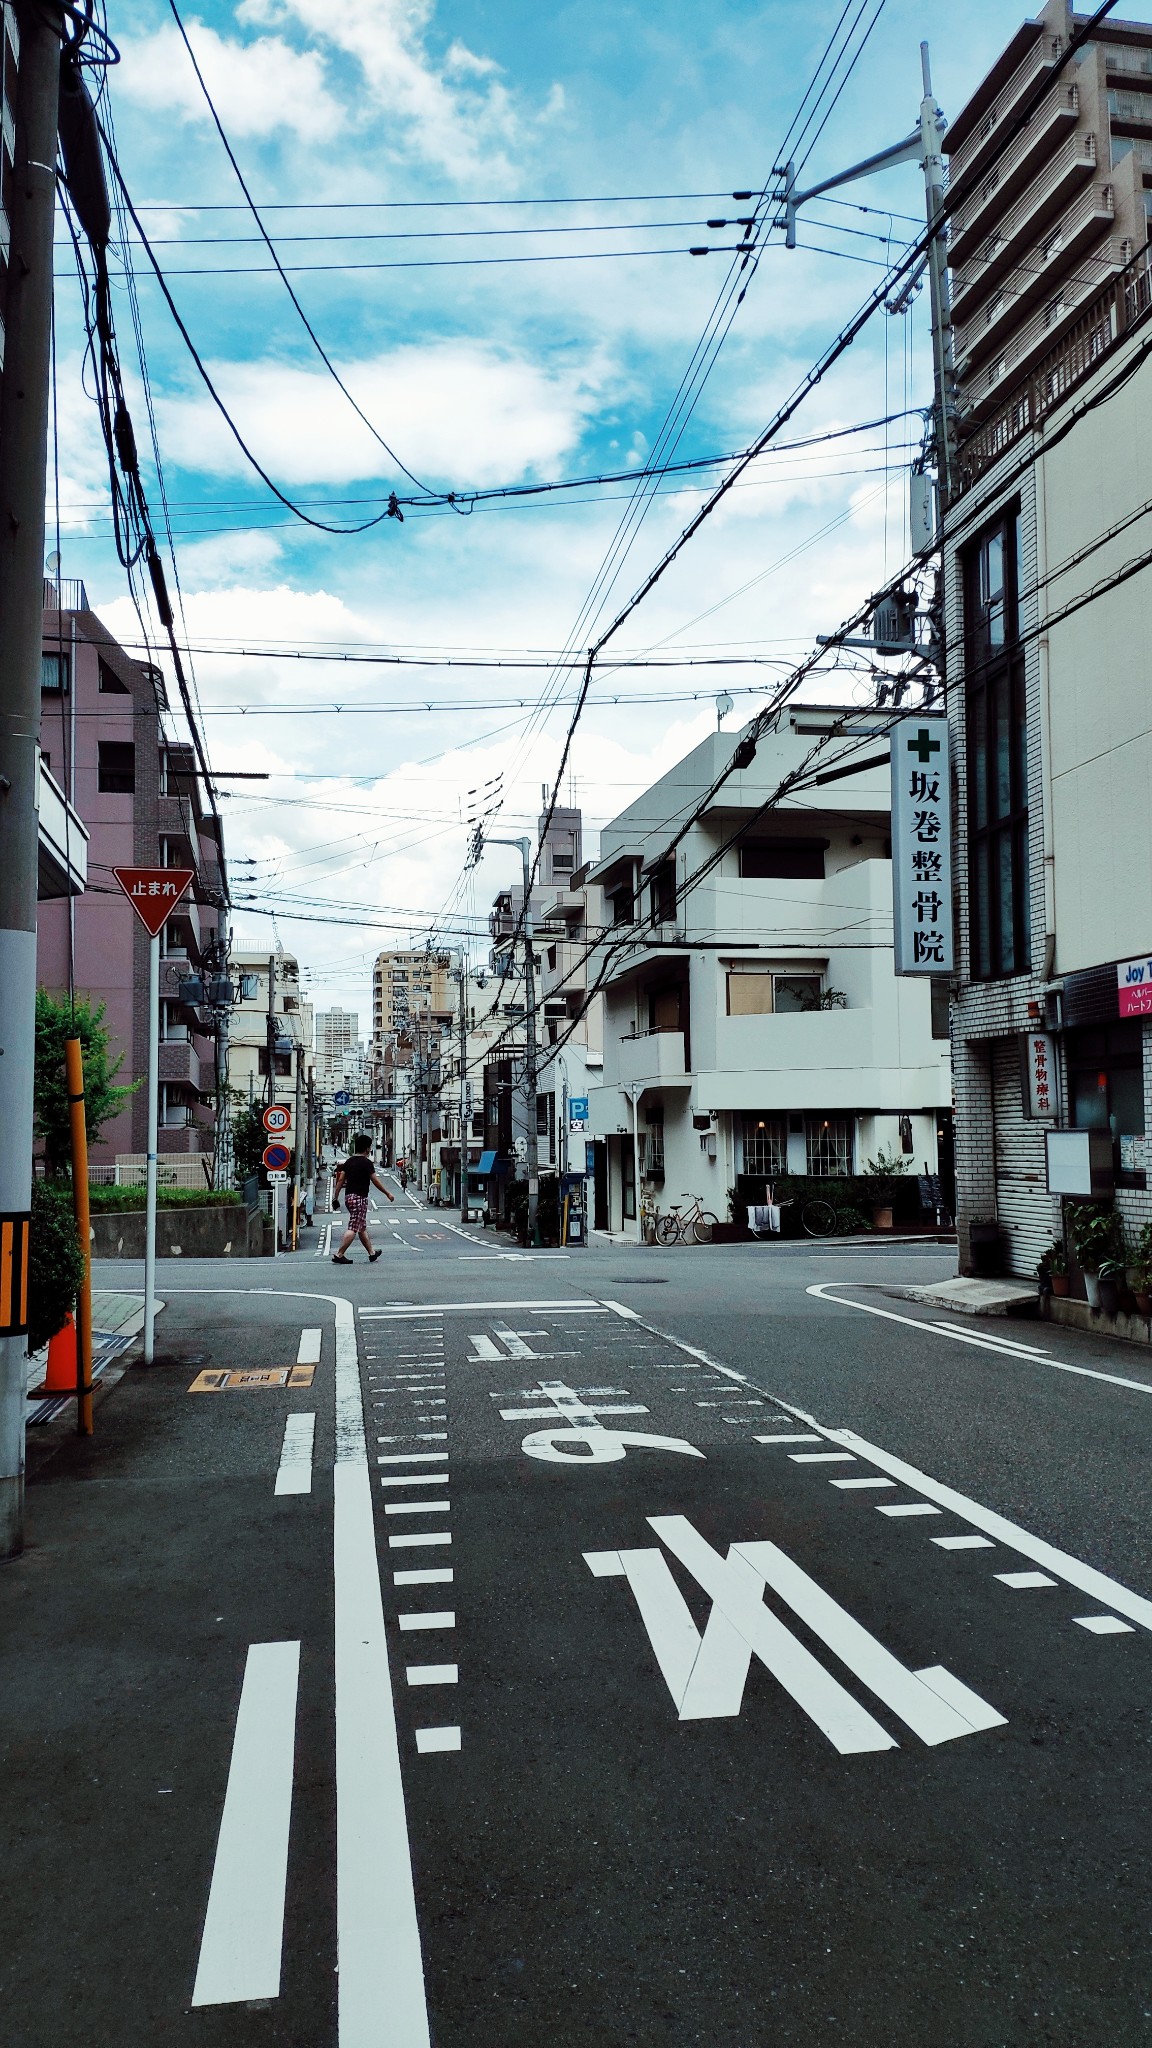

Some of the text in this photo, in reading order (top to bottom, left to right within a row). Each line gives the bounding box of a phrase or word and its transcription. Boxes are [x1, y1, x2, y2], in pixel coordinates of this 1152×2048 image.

[131, 880, 178, 896] 止まれ
[908, 770, 945, 963] 坂巻整骨院
[1125, 964, 1145, 983] Joy
[1034, 1040, 1050, 1110] 整骨物療科
[269, 1113, 285, 1126] 30
[466, 1321, 1009, 1755] 止まれ
